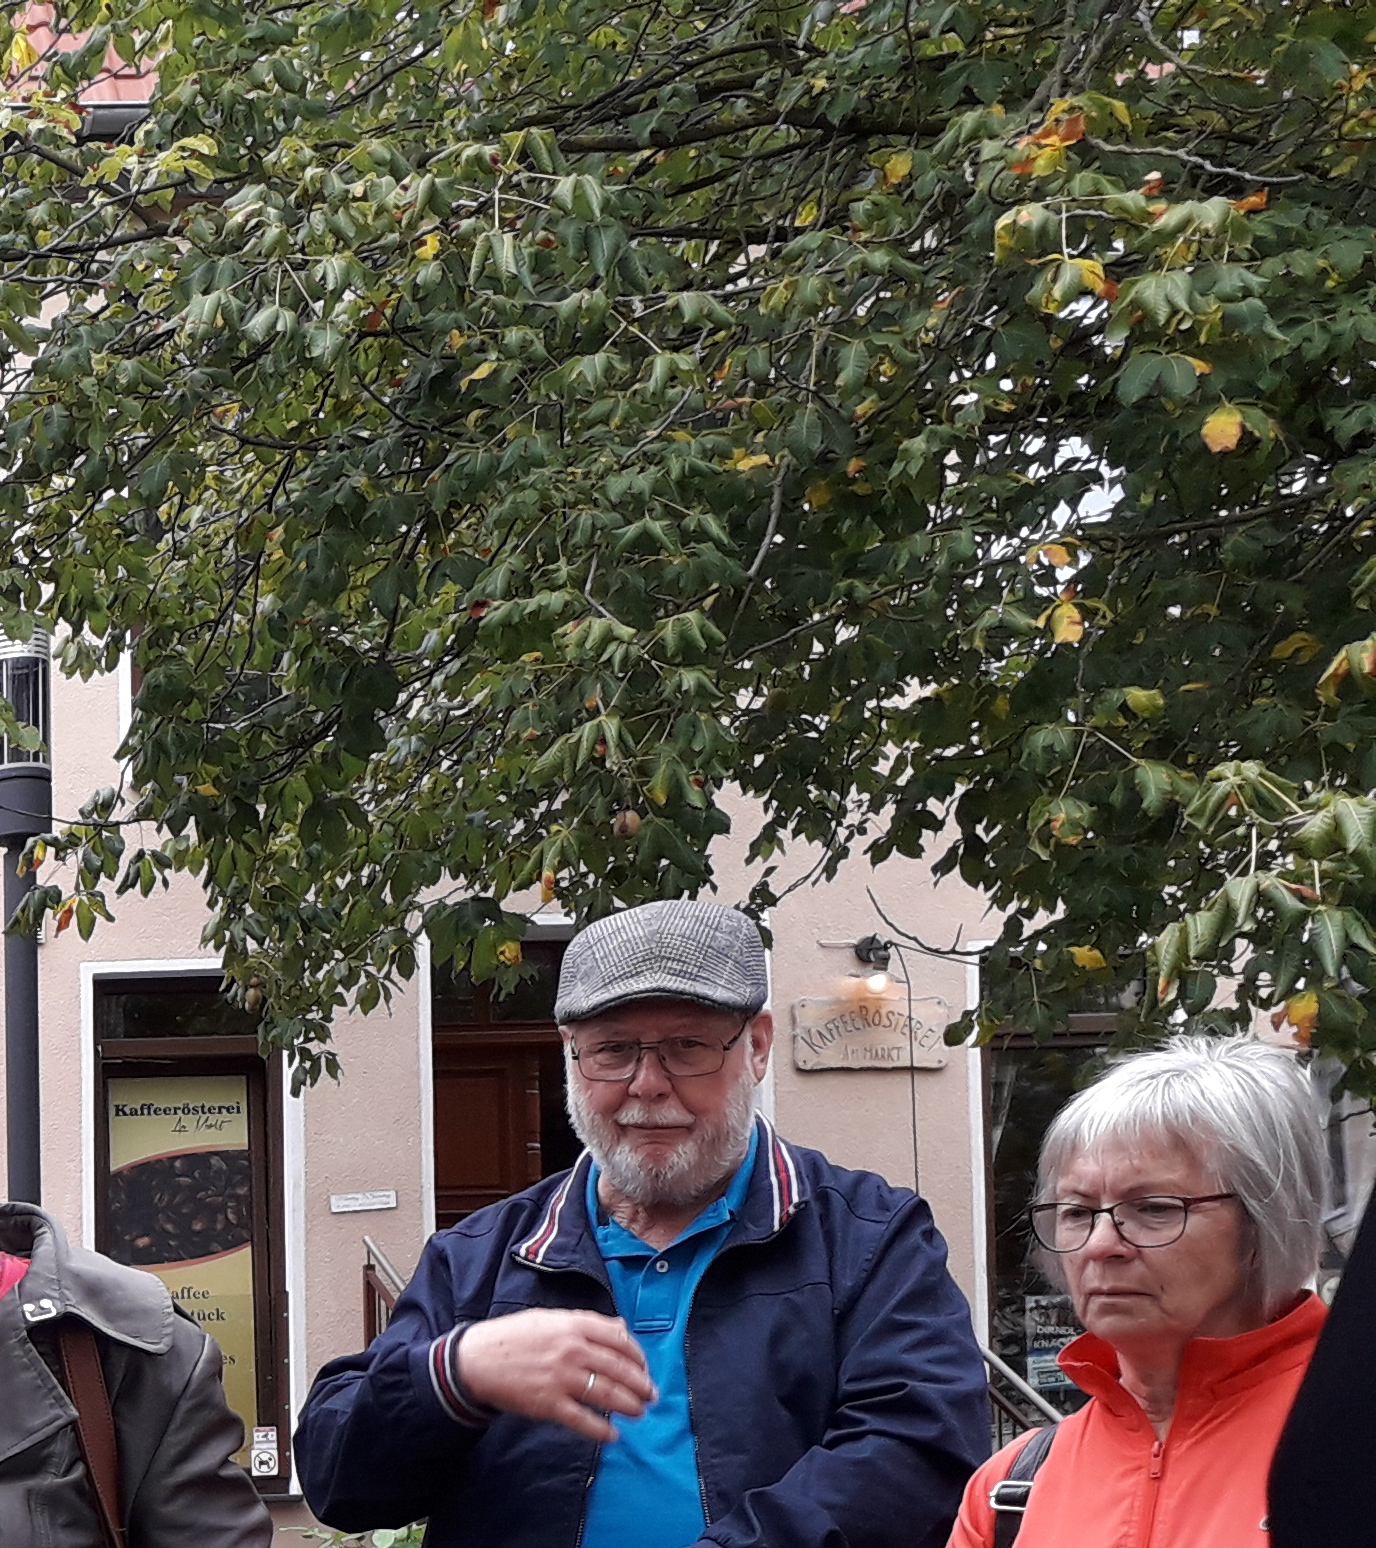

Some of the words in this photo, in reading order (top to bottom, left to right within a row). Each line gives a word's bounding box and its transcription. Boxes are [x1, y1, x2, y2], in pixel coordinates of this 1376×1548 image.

[801, 1006, 942, 1054] KAFFEERÖSTEREI
[864, 1046, 903, 1062] MARKT
[113, 1101, 242, 1117] Kaffeerösterei
[169, 1286, 211, 1300] affee
